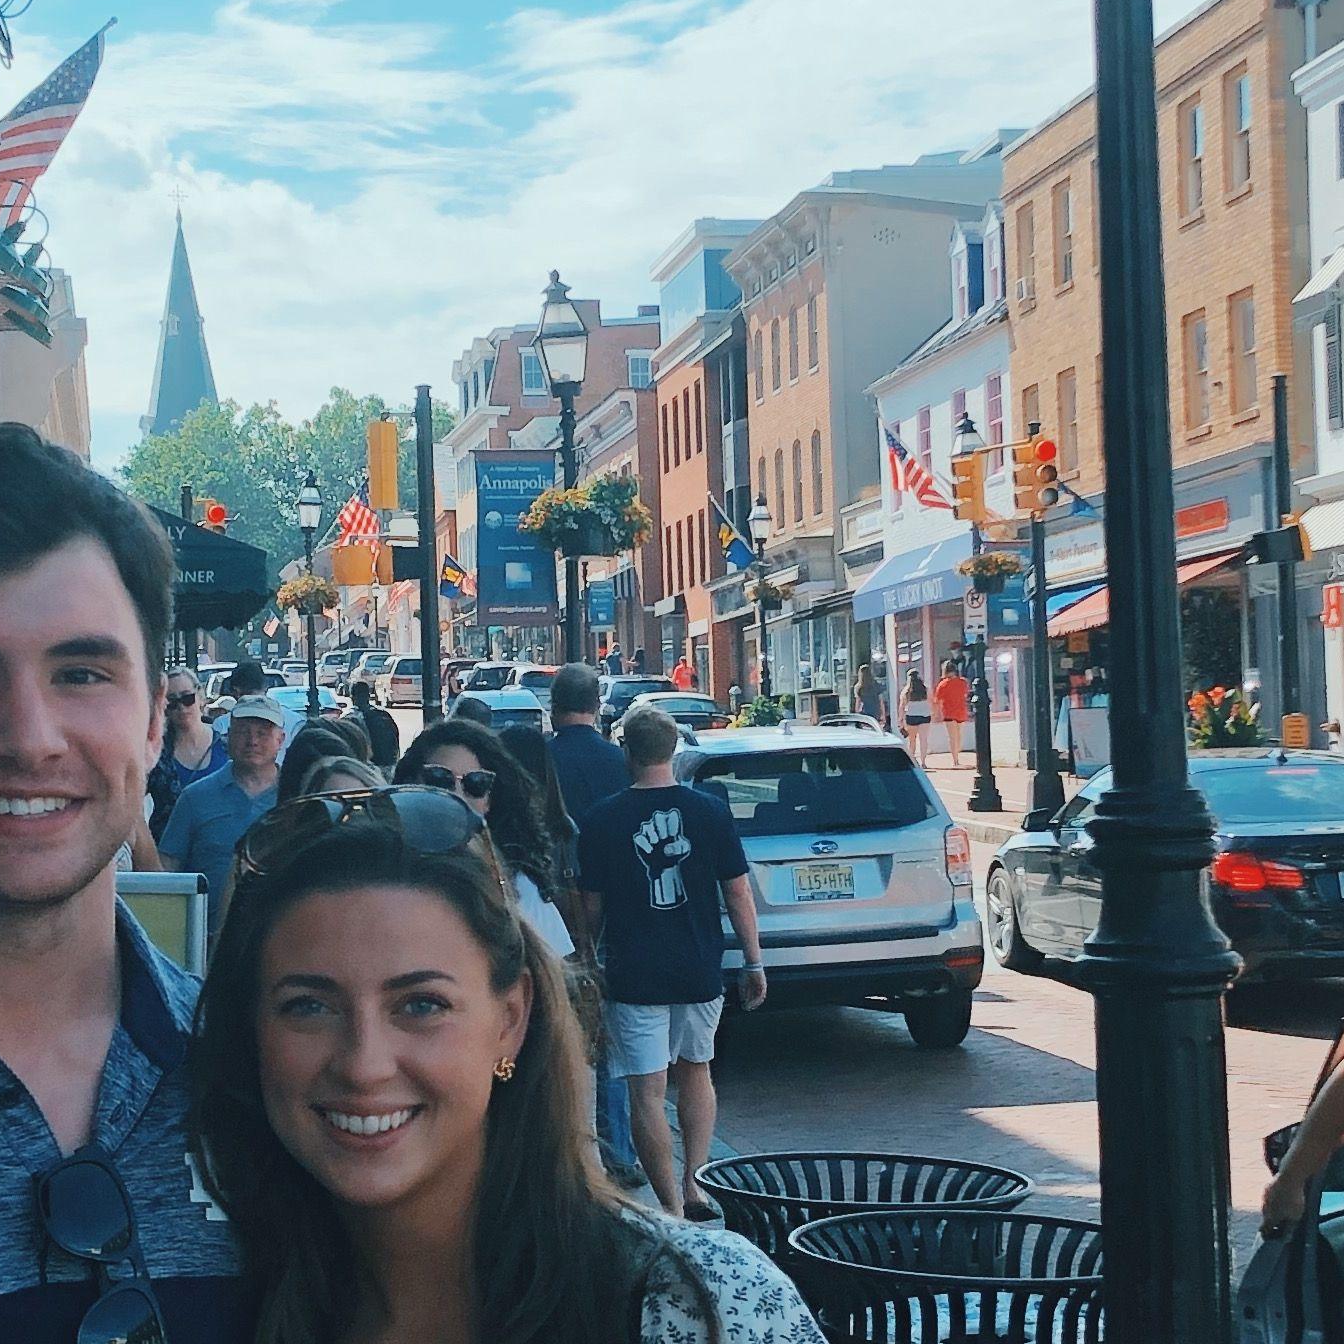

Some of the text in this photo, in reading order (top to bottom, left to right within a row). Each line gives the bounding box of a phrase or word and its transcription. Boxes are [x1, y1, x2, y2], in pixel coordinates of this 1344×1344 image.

[479, 474, 553, 494] Annapolis
[882, 577, 944, 611] THE LUCKY KNOT
